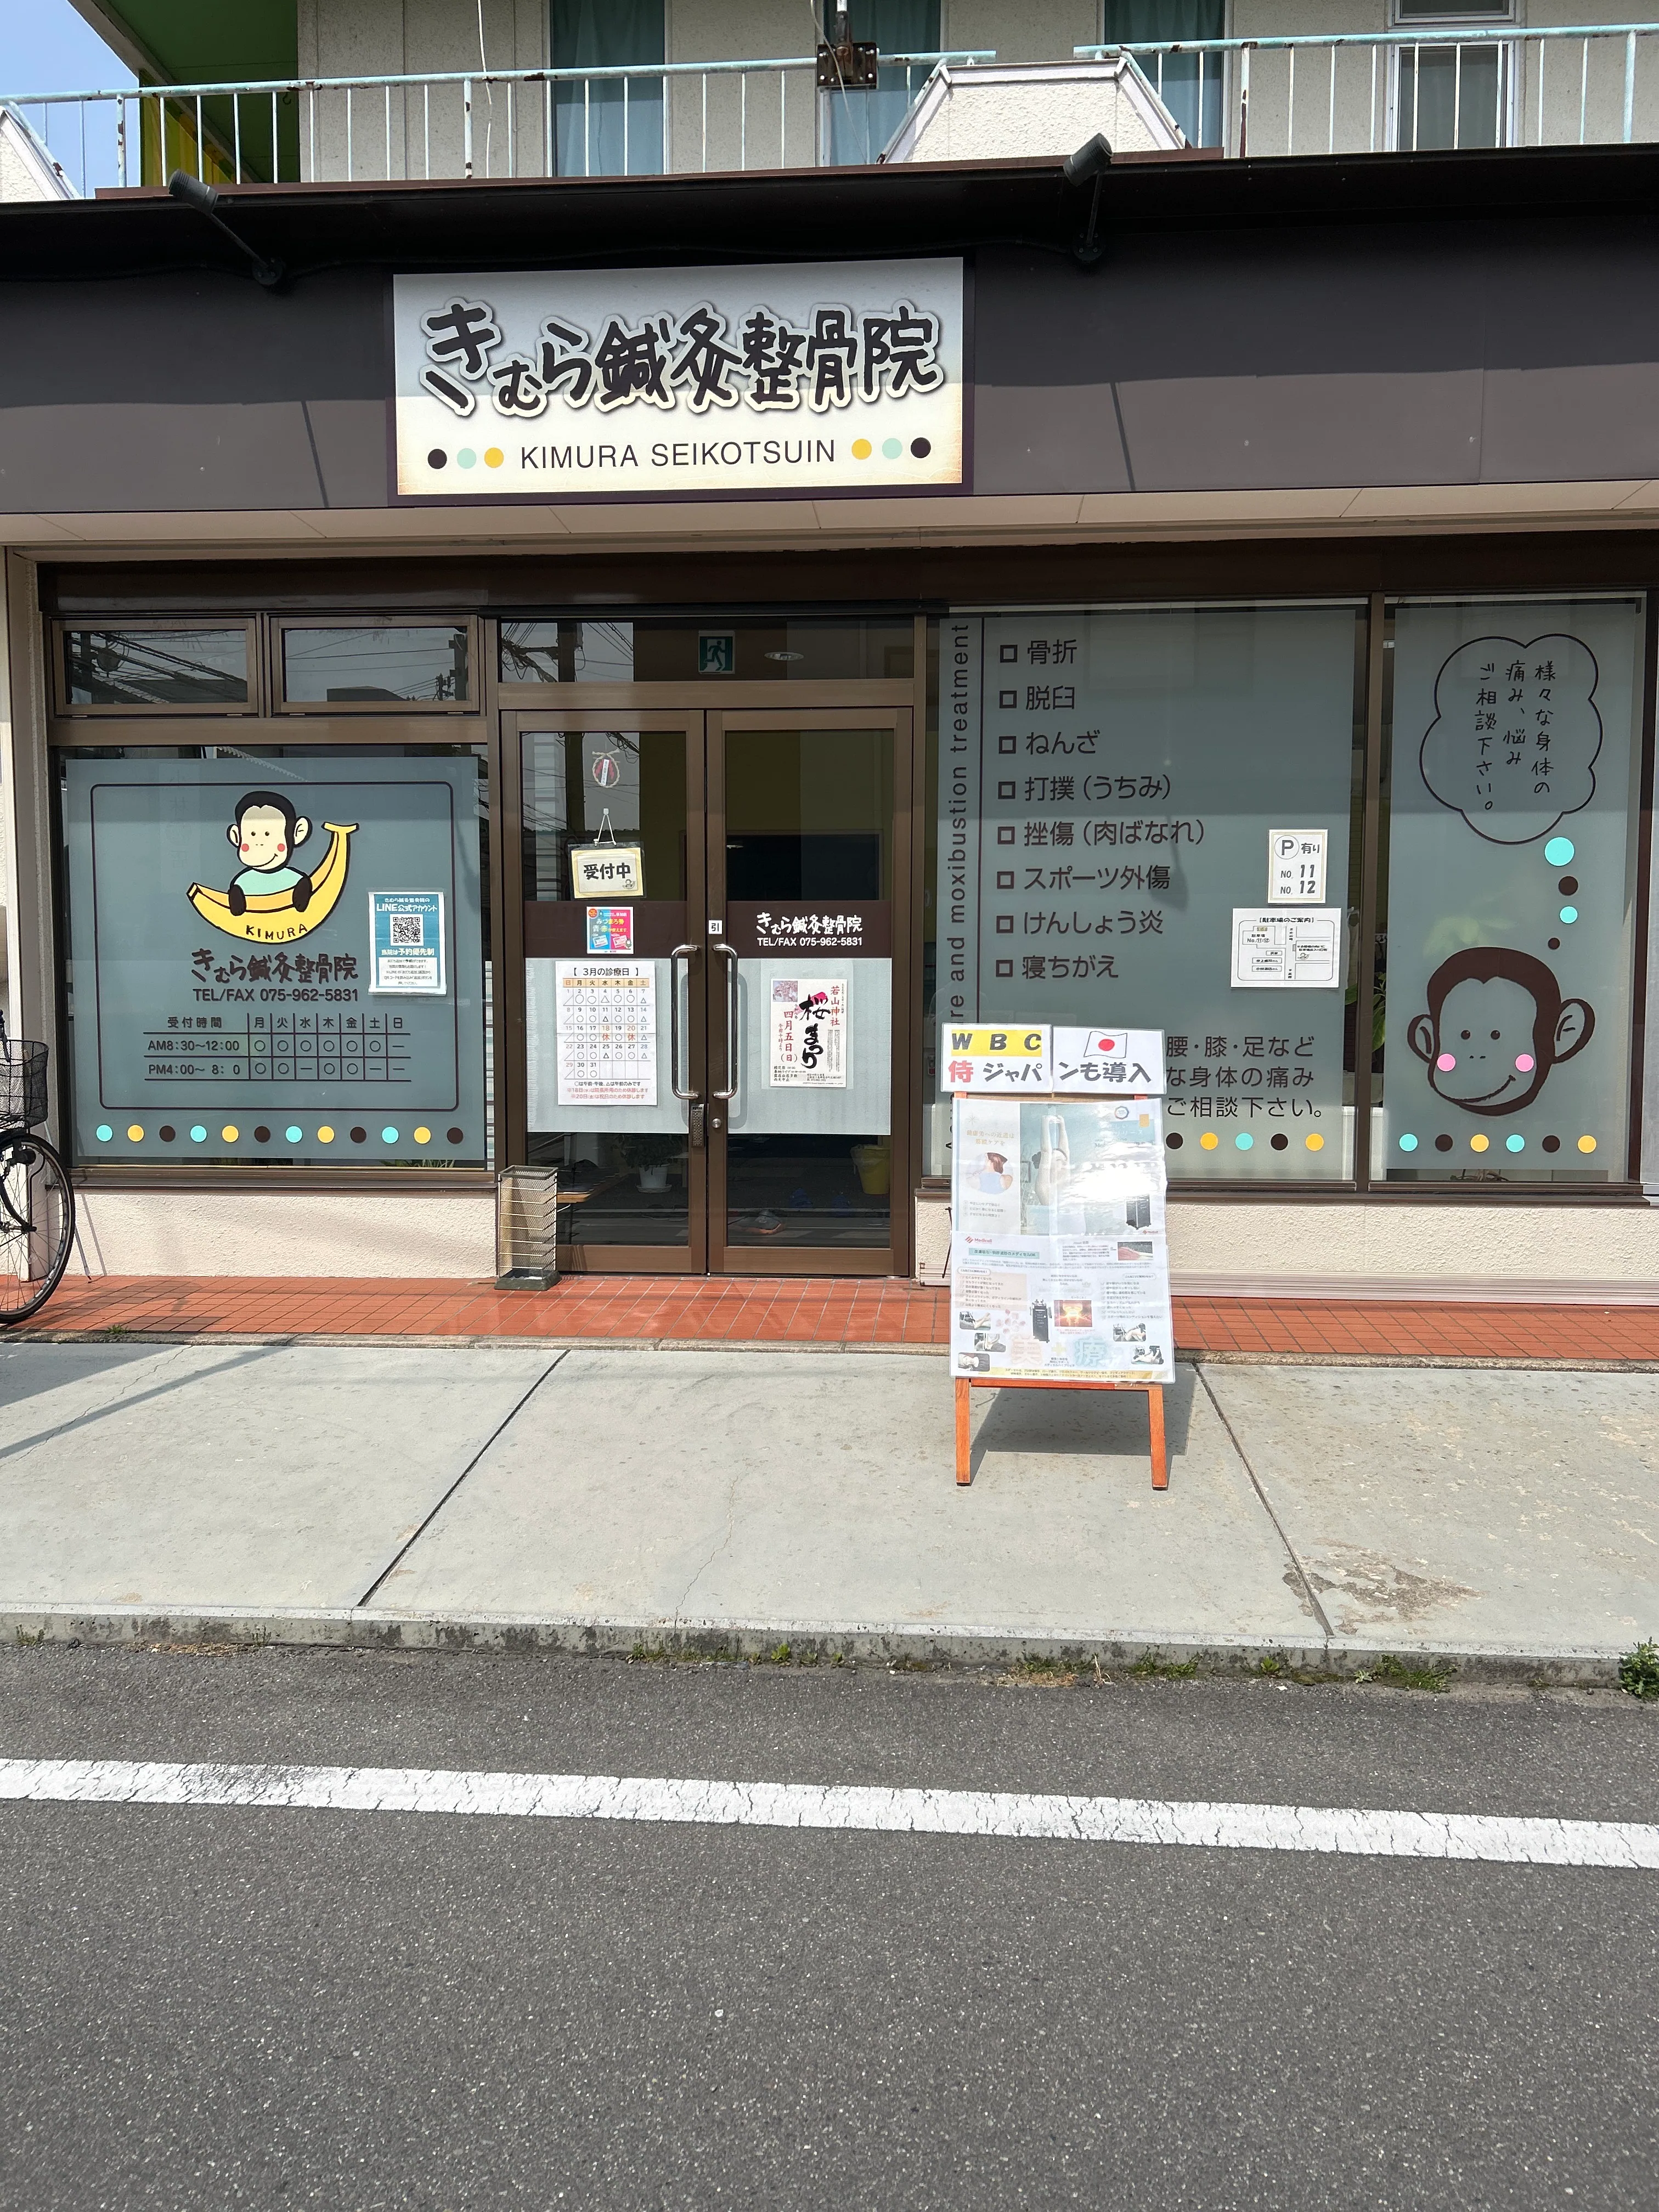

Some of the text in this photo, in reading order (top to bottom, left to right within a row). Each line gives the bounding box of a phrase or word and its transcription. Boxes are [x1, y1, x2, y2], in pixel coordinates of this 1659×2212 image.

[424, 301, 939, 414] きむら鍼灸整骨院
[521, 439, 835, 469] KIMURA SEIKOTSUIN
[1027, 639, 1077, 665] 骨折
[950, 624, 969, 753] treatment
[1025, 685, 1075, 711] 脱臼
[1502, 659, 1527, 765] 痛み、悩み
[1474, 663, 1498, 811] ご相談下さい。
[1531, 659, 1556, 794] 様々な身体の
[1025, 729, 1101, 755] ねんざ
[948, 767, 967, 923] moxibustion
[1301, 843, 1320, 854] 有り
[583, 862, 631, 880] 受付中
[1024, 865, 1171, 890] スポーツ外傷
[1300, 864, 1315, 878] 11
[1300, 881, 1316, 894] 12
[376, 904, 438, 912] LINE公式アカウント
[246, 924, 308, 940] KIMURA
[711, 923, 719, 932] 引
[756, 912, 863, 935] きむら鍼灸整骨院
[1023, 910, 1163, 935] けんしょう炎
[757, 937, 862, 946] TEL/FAX 075-962-5831
[191, 948, 358, 984] きむら鍼灸整骨院
[583, 968, 630, 976] 3月の診療日
[949, 937, 965, 982] and
[1022, 955, 1119, 980] 寝ちがえ
[193, 988, 358, 1002] TEL/FAX 075-962-5831
[830, 985, 840, 1027] 若山神社
[167, 1017, 403, 1029] 受付時間 月 火 水 木 金 土 日
[602, 1033, 635, 1041] 休 休
[1167, 1096, 1322, 1118] ご相談下さい。
